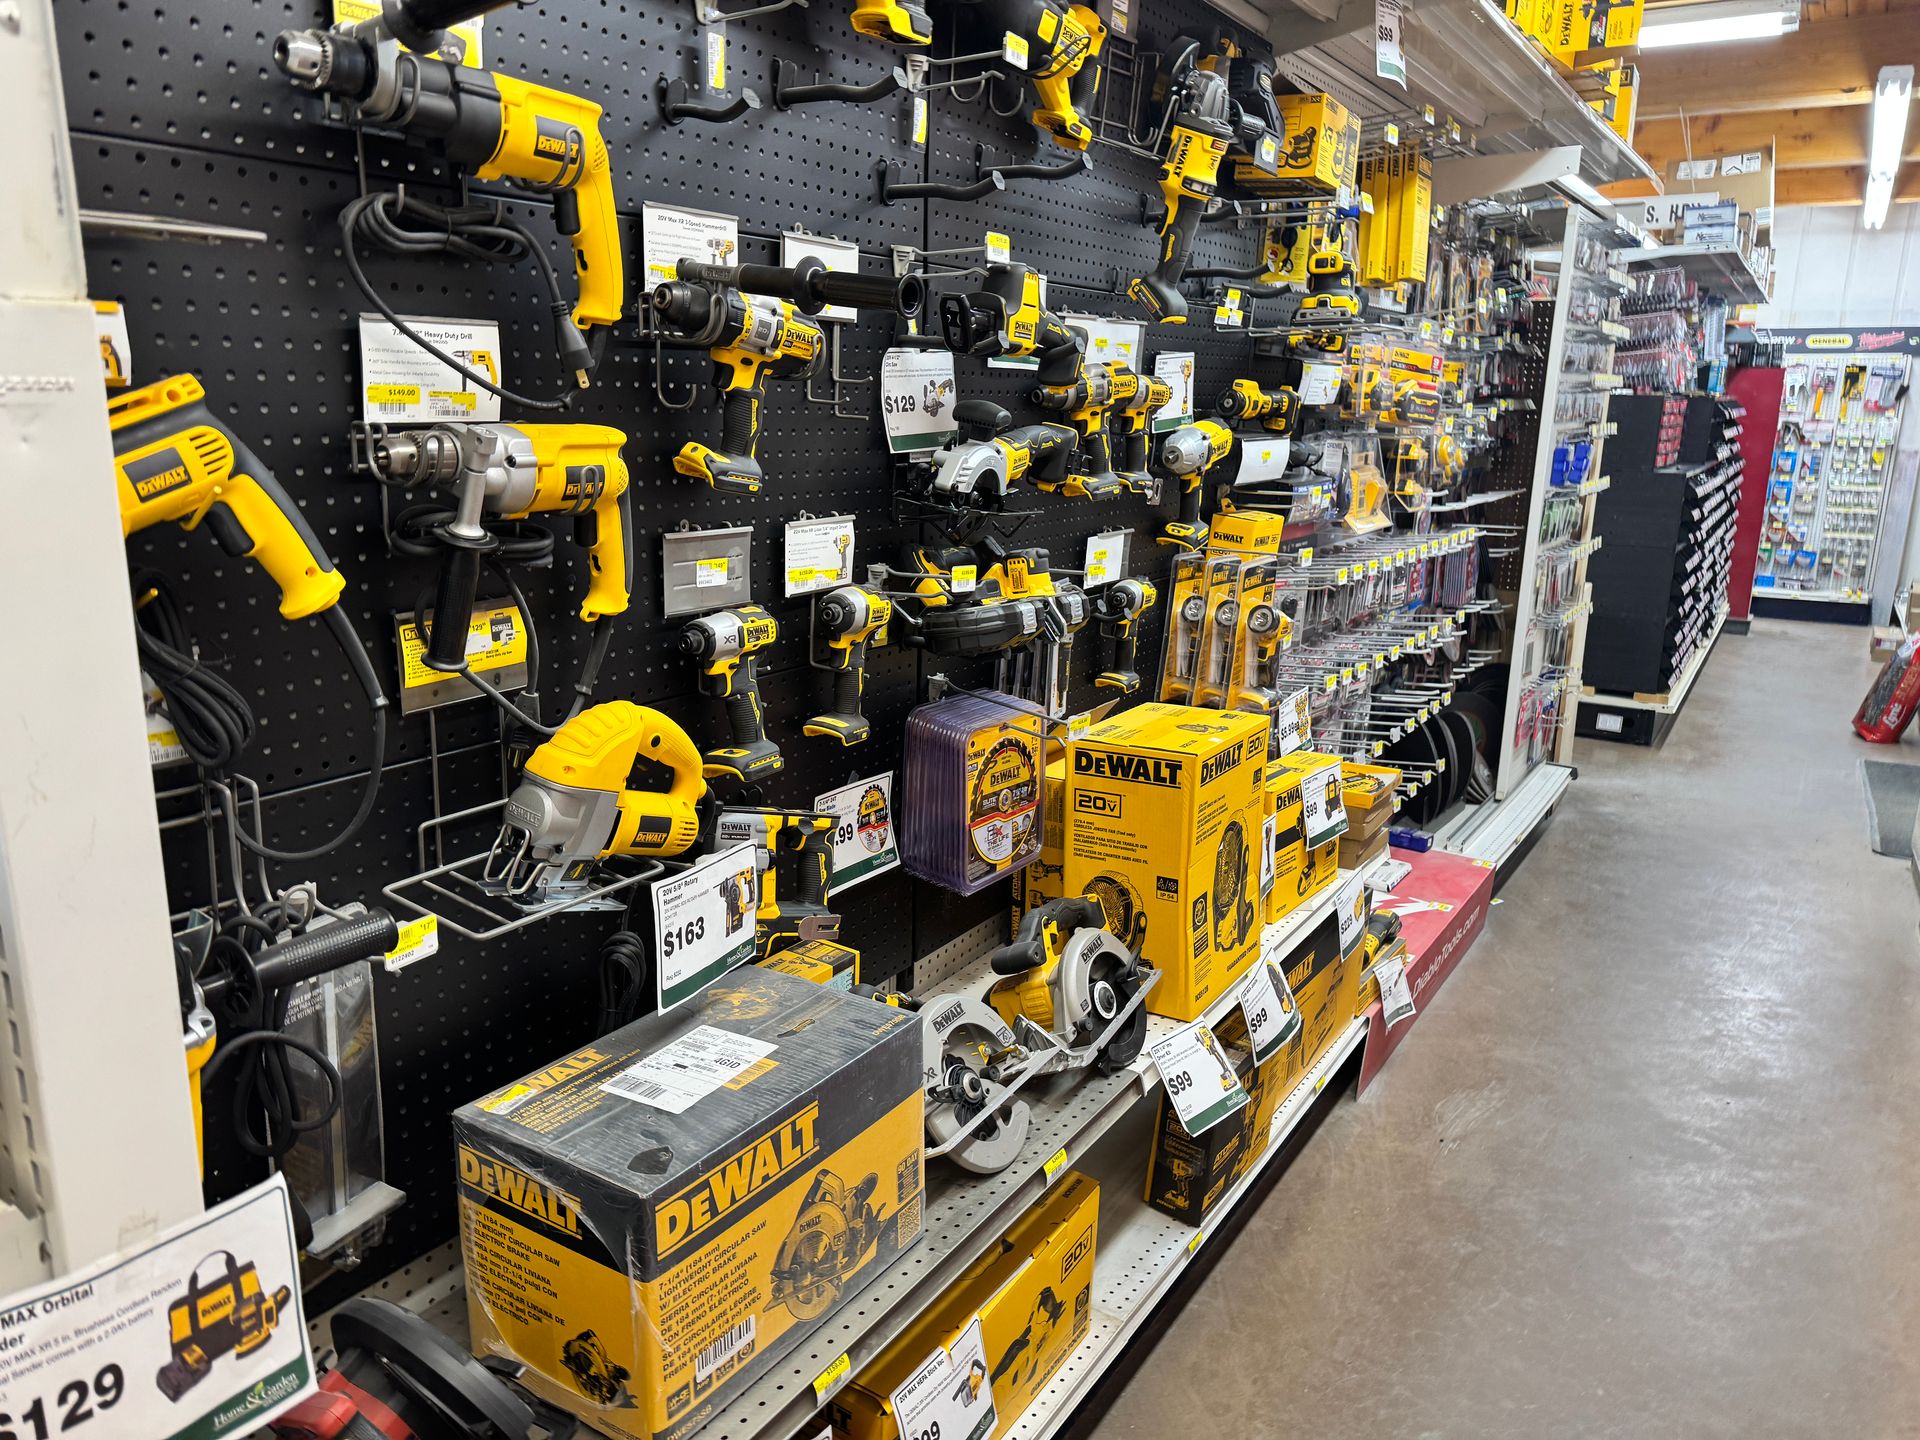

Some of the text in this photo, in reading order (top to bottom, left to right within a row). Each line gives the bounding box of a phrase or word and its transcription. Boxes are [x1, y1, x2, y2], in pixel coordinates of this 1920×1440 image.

[537, 135, 579, 157] DEWAT
[885, 395, 915, 414] $129
[136, 465, 189, 497] DEWALT
[1213, 532, 1244, 544] DEWALT
[724, 635, 737, 645] XR
[990, 766, 1020, 787] DEWALT
[1075, 750, 1183, 786] DEWALT
[1201, 743, 1243, 783] DEWALT
[1078, 794, 1116, 812] 20V
[1277, 785, 1303, 811] DEWA
[509, 803, 543, 827] DEWALT
[721, 823, 752, 832] DEWALT
[636, 832, 668, 843] DEWALT
[835, 822, 854, 846] .99
[663, 888, 673, 897] 20V
[684, 877, 699, 889] Rotary
[664, 893, 683, 906] Hammer
[664, 916, 705, 960] $163
[1081, 936, 1104, 965] DEWALT
[1412, 905, 1481, 999] DiabloTools.com
[1286, 953, 1316, 990] WALT
[932, 1002, 966, 1033] DEWALT
[1251, 1008, 1268, 1034] $99
[525, 1049, 606, 1091] WALT
[924, 1067, 938, 1083] XR
[1168, 1070, 1193, 1097] $99
[908, 1150, 920, 1168] DAY
[459, 1146, 582, 1234] DEWALT
[656, 1104, 820, 1255] DEWALT
[484, 1213, 514, 1235] (184 mm)
[474, 1228, 531, 1263] ELECTRIC BRAKE
[508, 1236, 560, 1267] CIRCULAR SAW
[658, 1219, 768, 1301] LIGHTWEIGHT CIRCULAR SAW
[1064, 1236, 1090, 1275] 20V
[489, 1249, 552, 1287] CIRCULAR LIVIANA
[490, 1259, 502, 1270] mm
[502, 1265, 523, 1282] (7-1/4
[524, 1276, 542, 1293] pulg)
[542, 1286, 558, 1300] CON
[658, 1243, 721, 1291] 7-1/4" (184 mm)
[659, 1252, 738, 1312] W/ ELECTRIC BRAKE
[660, 1252, 758, 1327] SIERRA CIRCULAR LIVIANA
[661, 1269, 748, 1337] DE 184 mm (7-1/4 pulg)
[1, 1284, 94, 1330] MAX Orbital
[11, 1348, 39, 1365] MAX
[74, 1312, 116, 1342] Brushless
[116, 1298, 150, 1320] Cordless
[150, 1278, 183, 1304] Random
[202, 1296, 233, 1318] DEWALT
[681, 1310, 707, 1335] FRENO
[662, 1358, 676, 1373] DE
[677, 1347, 692, 1362] 184
[692, 1335, 708, 1352] mm
[717, 1316, 730, 1333] 1/4
[731, 1308, 742, 1323] po)
[743, 1292, 762, 1314] AVEC
[683, 1306, 728, 1346] CIRCULAIRE
[11, 1361, 44, 1383] Sander
[45, 1349, 76, 1369] comes
[77, 1338, 96, 1356] with
[104, 1323, 126, 1342] 2.0Ah
[127, 1306, 155, 1331] battery
[663, 1356, 688, 1382] FREIN
[826, 1358, 845, 1377] $159.00
[906, 1382, 918, 1395] MAX
[917, 1374, 928, 1387] HEPA
[928, 1364, 937, 1377] Stick
[1030, 1349, 1067, 1397] GUARANTEED
[214, 1404, 246, 1429] Home
[261, 1372, 298, 1402] Garden
[912, 1420, 941, 1440] 99
